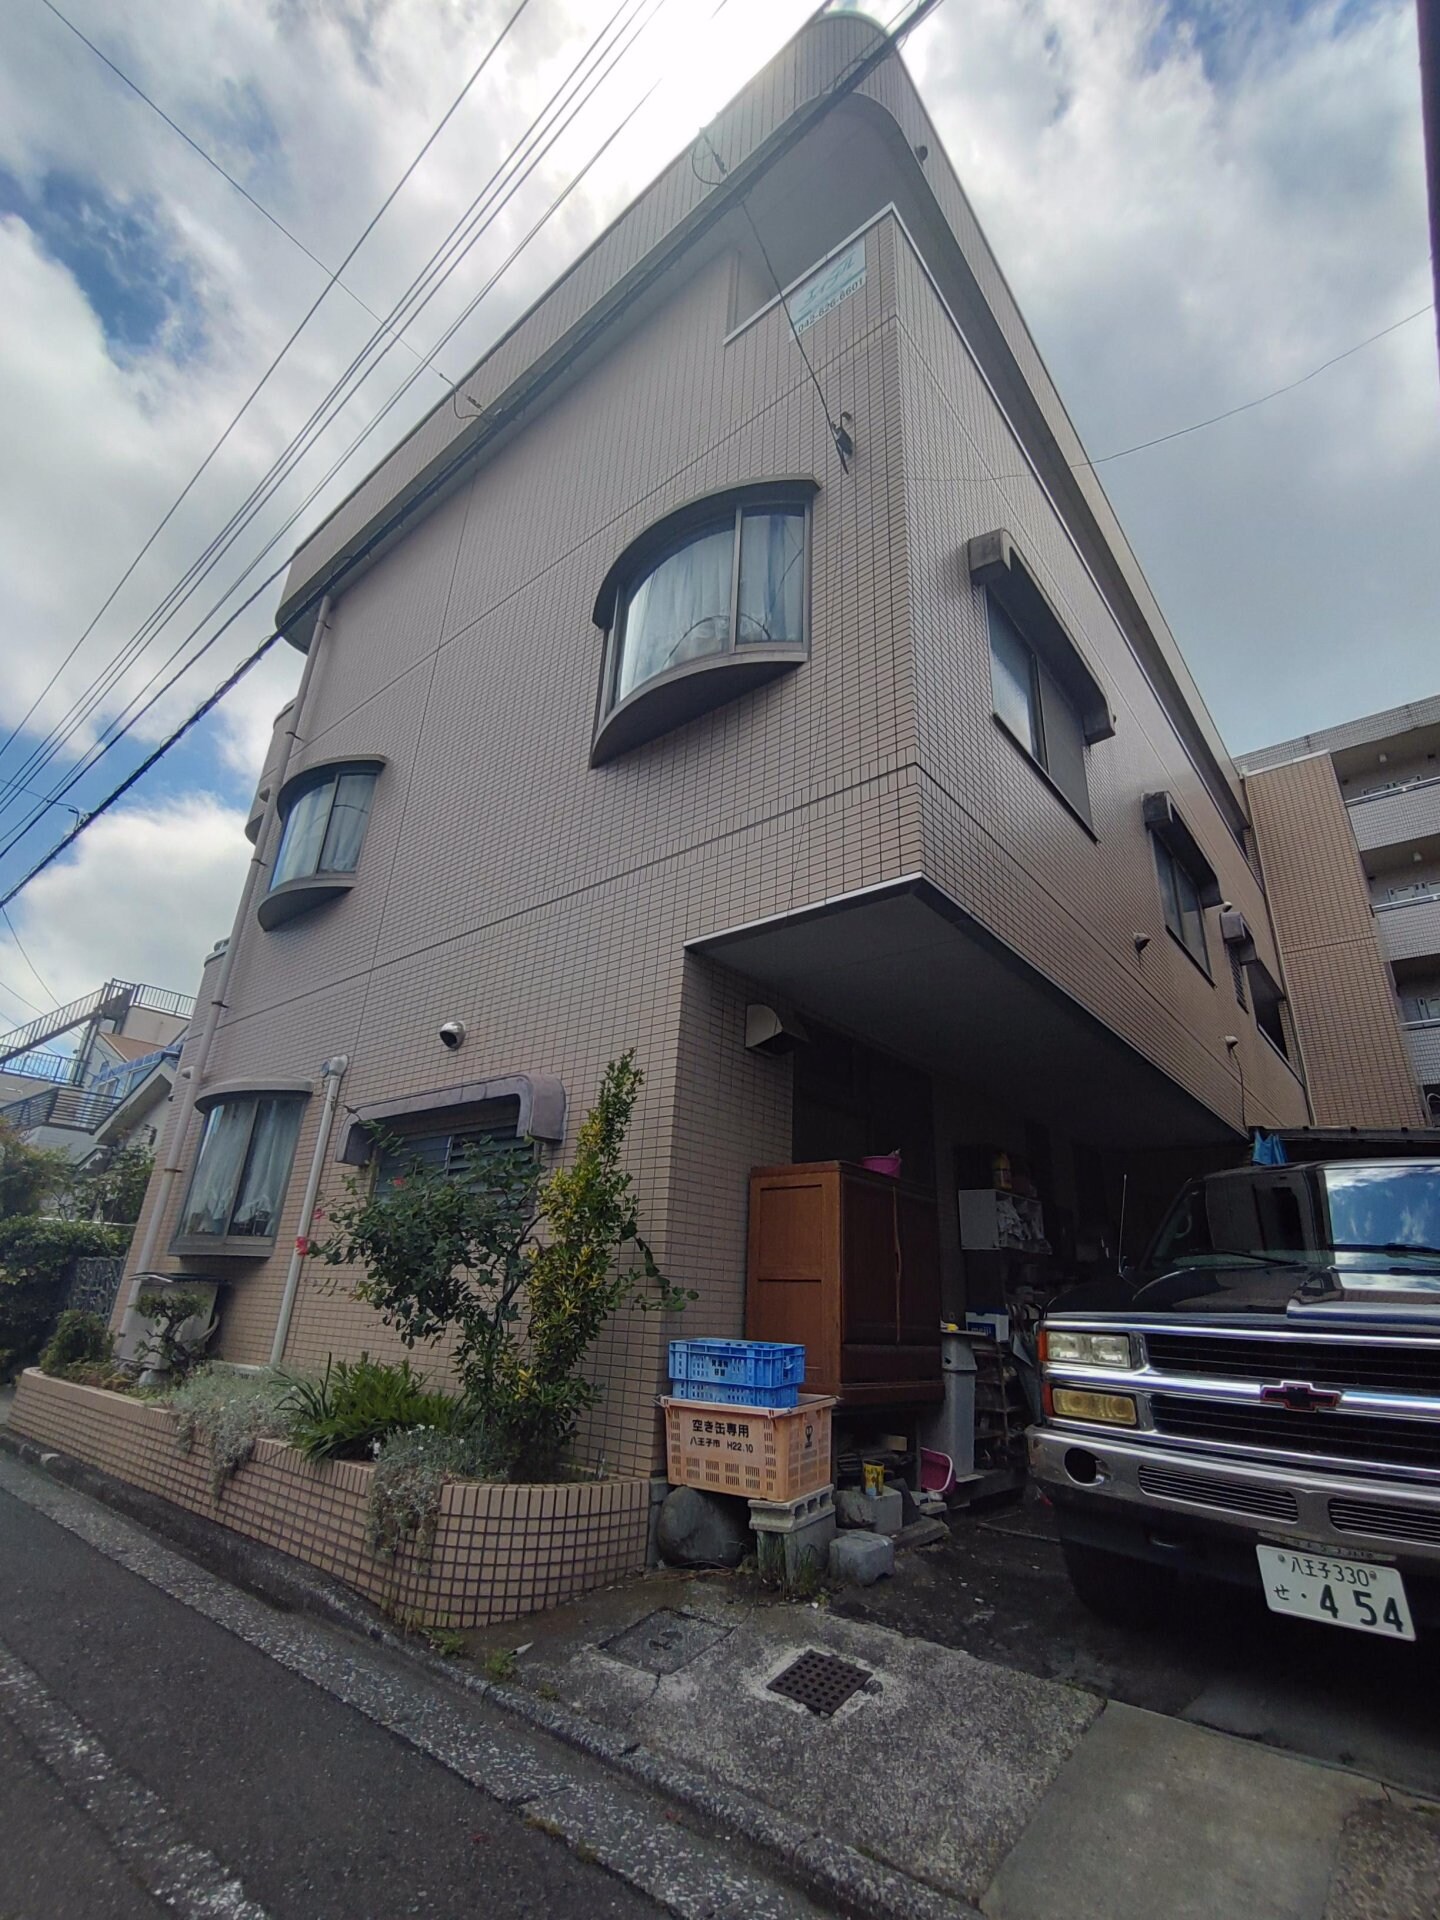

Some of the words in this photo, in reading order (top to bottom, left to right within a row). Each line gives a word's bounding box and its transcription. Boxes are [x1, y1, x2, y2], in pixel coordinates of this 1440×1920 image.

[692, 1419, 749, 1438] 空き缶専用
[690, 1436, 721, 1448] 八王子市
[727, 1440, 754, 1453] H22.10
[1273, 1584, 1290, 1601] せ
